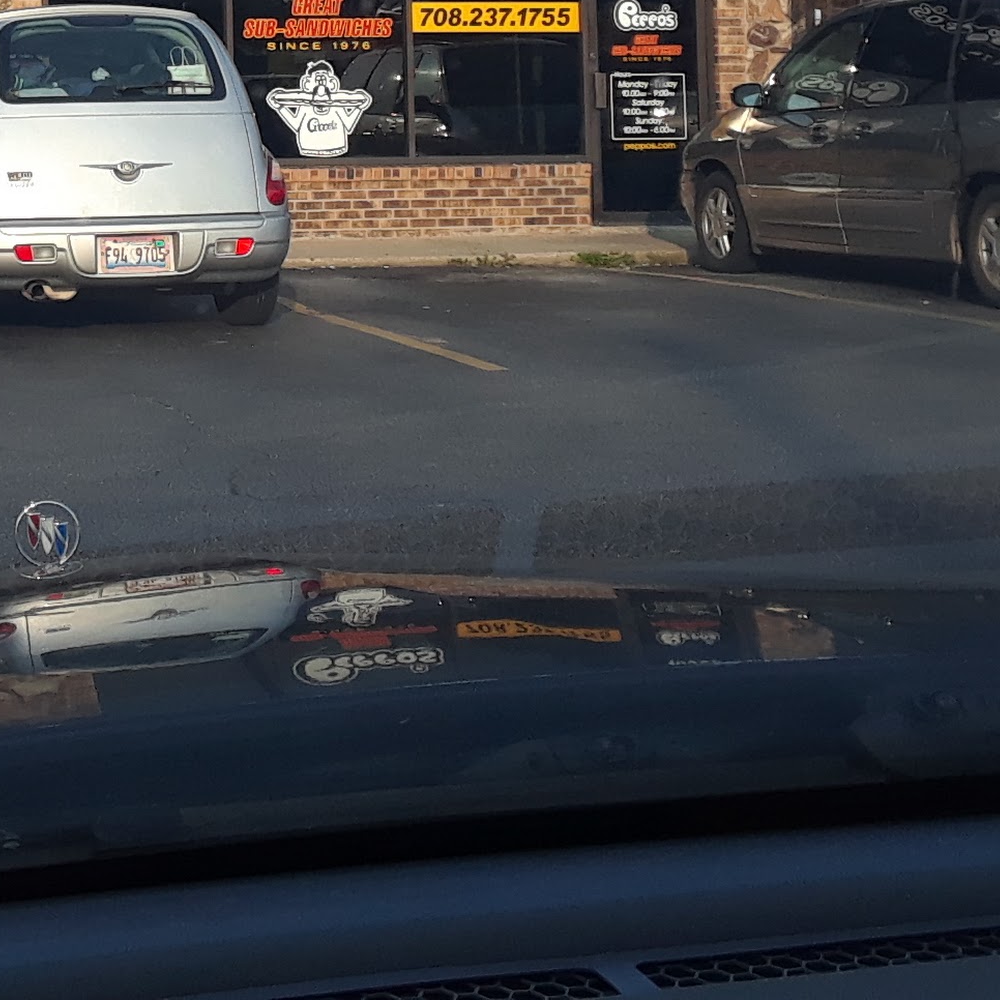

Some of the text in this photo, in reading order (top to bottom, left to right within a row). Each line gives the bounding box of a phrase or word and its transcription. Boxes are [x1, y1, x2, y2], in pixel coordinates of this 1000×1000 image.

[420, 7, 571, 27] 708.237.1755
[243, 18, 393, 38] SUB-SANDWICHES
[266, 41, 371, 50] SINCE 1976
[105, 246, 128, 264] F94
